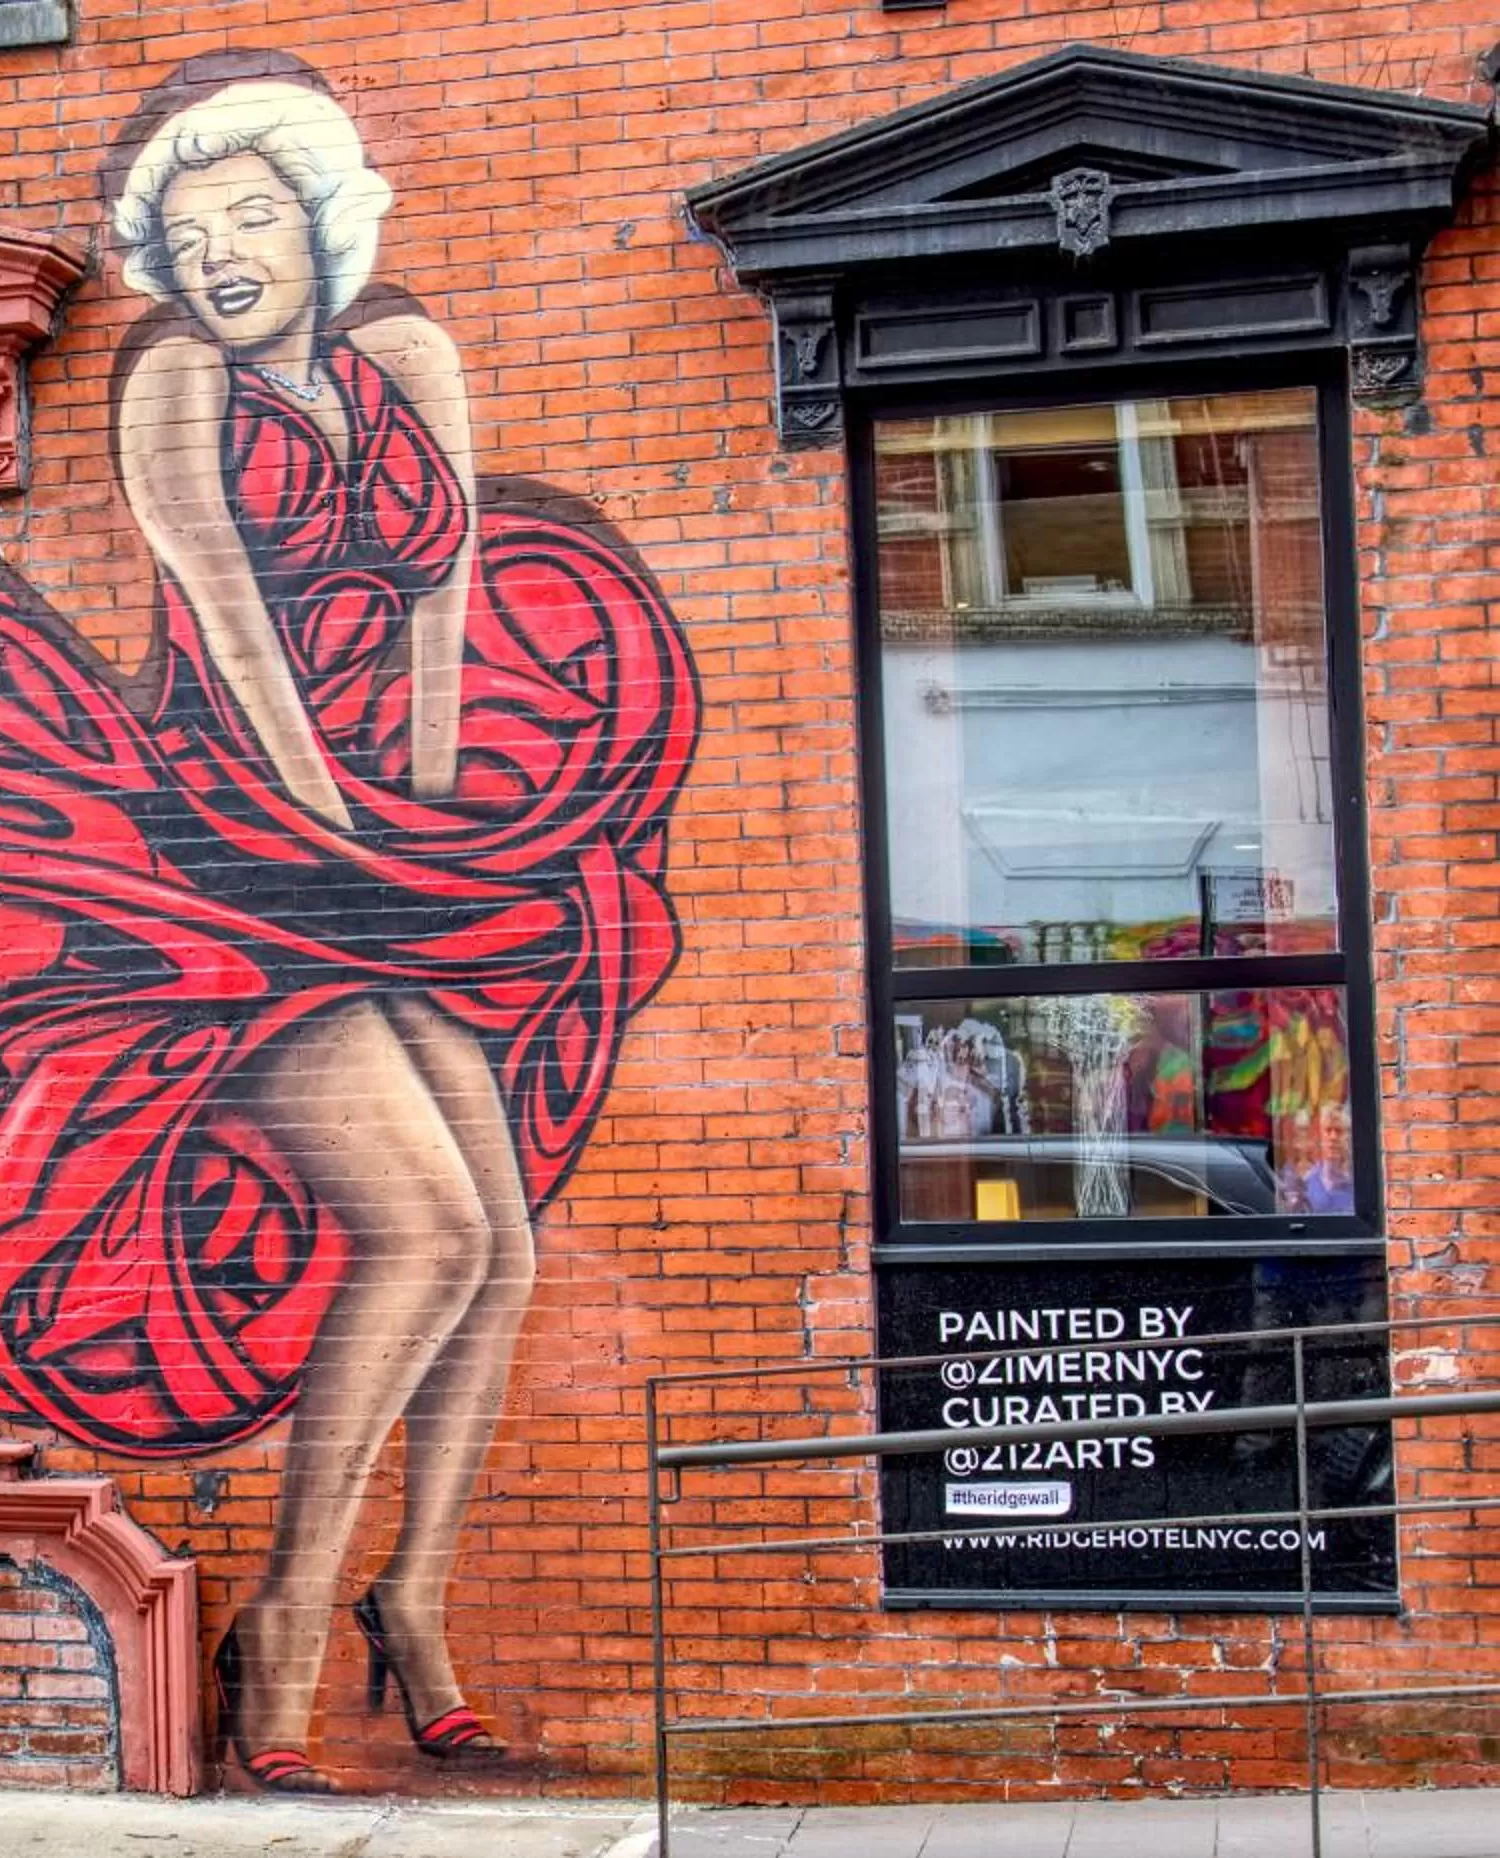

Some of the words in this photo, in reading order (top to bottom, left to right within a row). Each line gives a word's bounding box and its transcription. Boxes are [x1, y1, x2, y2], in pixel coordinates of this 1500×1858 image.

[939, 1308, 1125, 1342] PAINTED
[1139, 1306, 1194, 1338] BY
[941, 1349, 1204, 1390] @ZIMERNYC
[942, 1392, 1145, 1428] CURATED
[1160, 1390, 1215, 1414] BY
[944, 1436, 1156, 1476] @212ARTS
[952, 1488, 1060, 1509] #theridgewall
